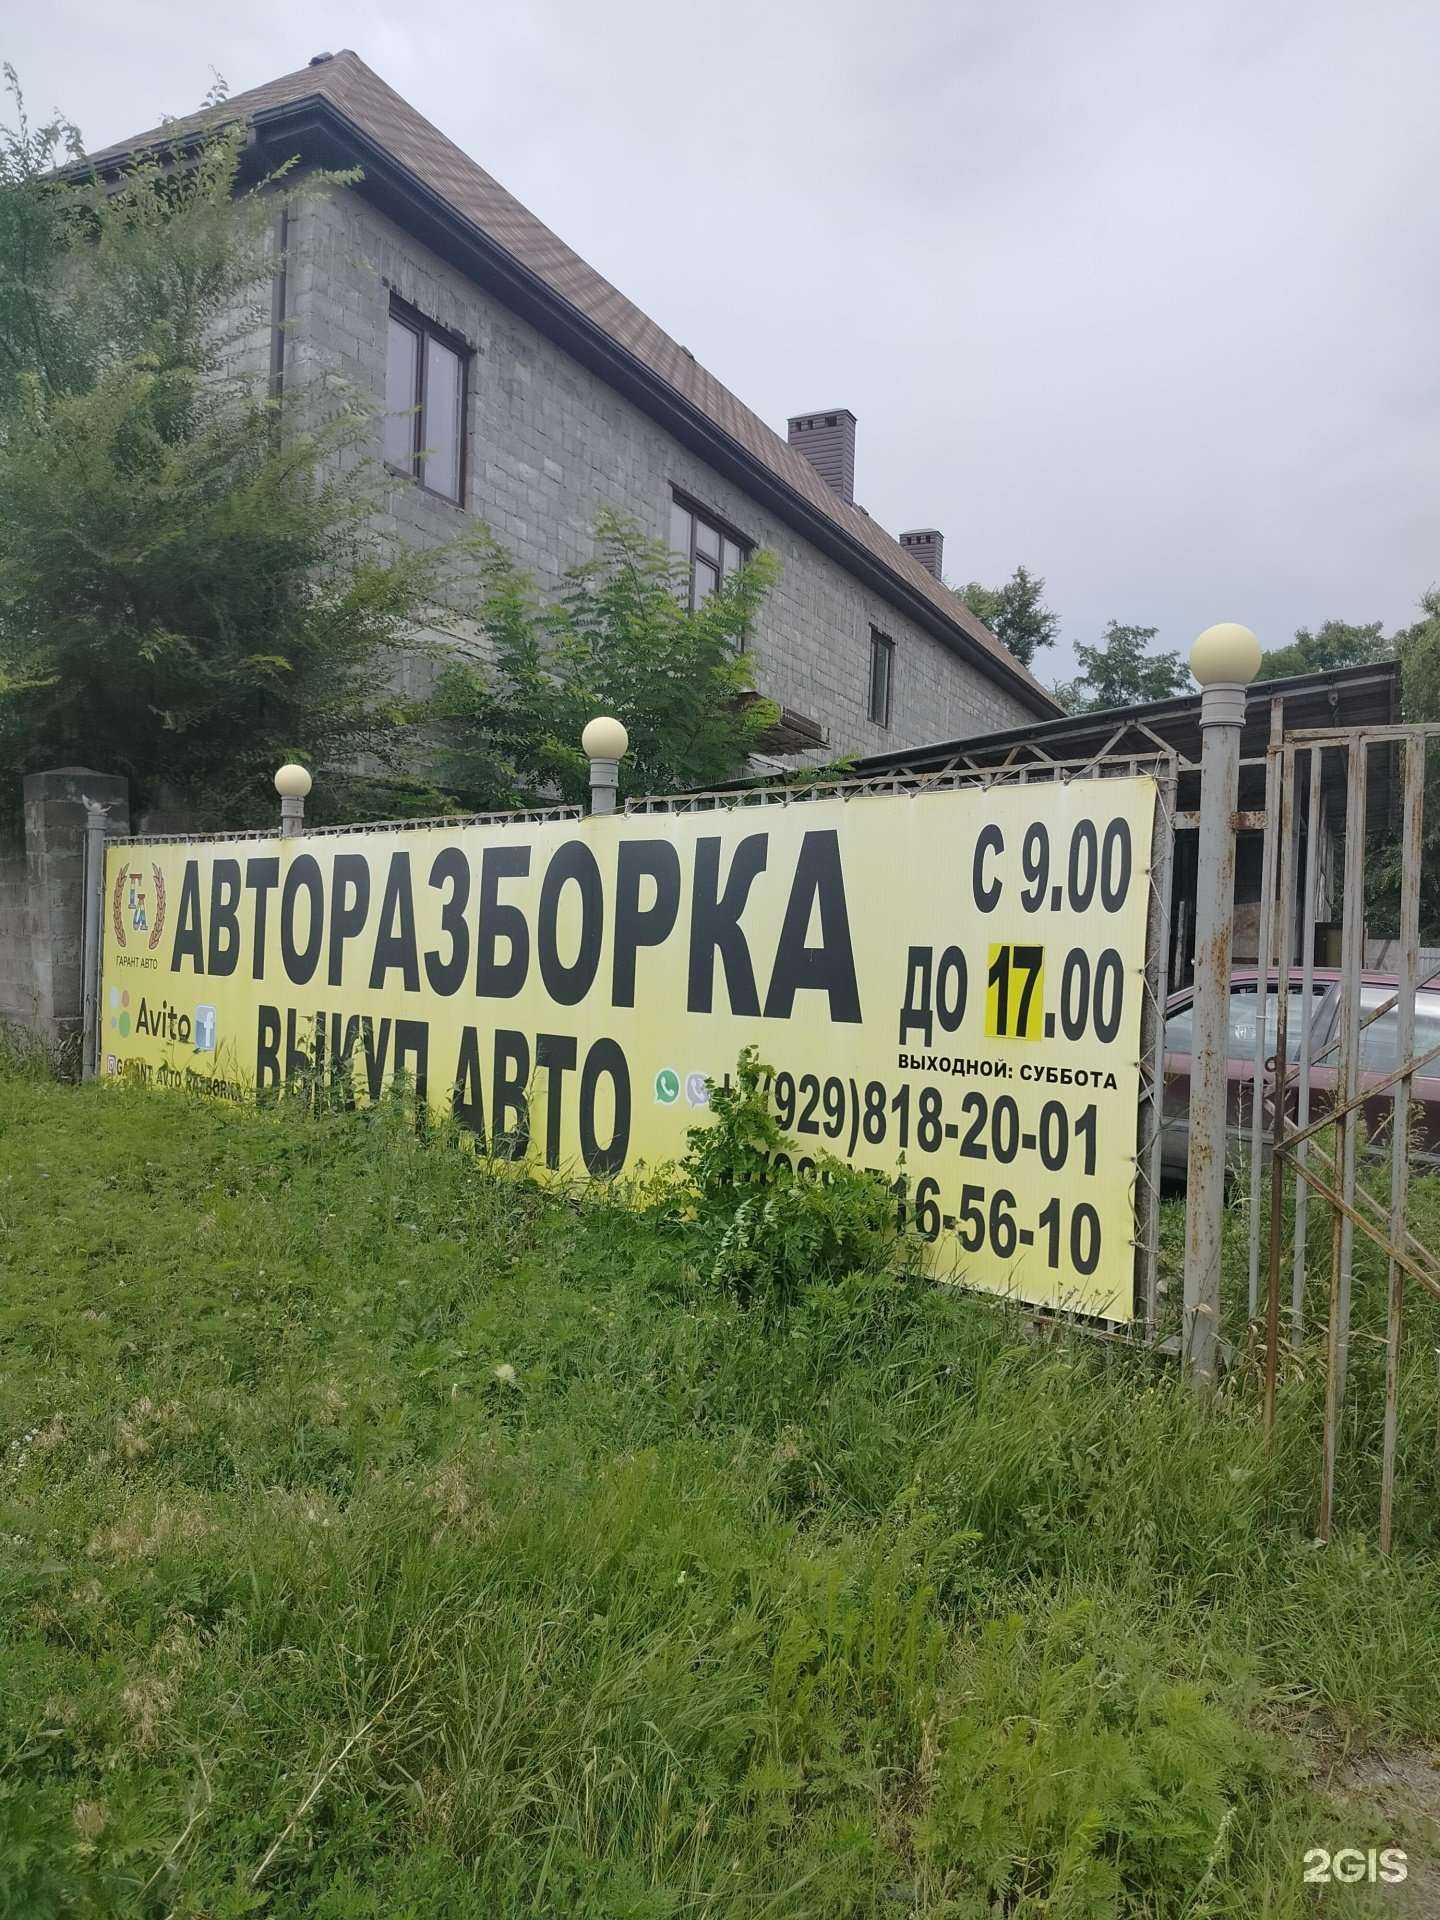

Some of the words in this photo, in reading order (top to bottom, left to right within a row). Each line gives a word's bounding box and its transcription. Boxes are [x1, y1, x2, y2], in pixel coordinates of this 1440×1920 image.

[1020, 817, 1132, 913] 9.00
[116, 955, 139, 968] ГАРАНТ
[141, 957, 158, 970] АВТО
[170, 829, 863, 1024] АВТОРАЗБОРКА
[136, 997, 191, 1041] Avito
[899, 945, 968, 1047] ДО
[987, 945, 1124, 1044] 17.00
[256, 1005, 430, 1143] ВЫКУП
[453, 1026, 631, 1182] АВТО
[899, 1053, 1014, 1079] ВЫХОДНОЙ:
[1020, 1064, 1119, 1090] СУББОТА
